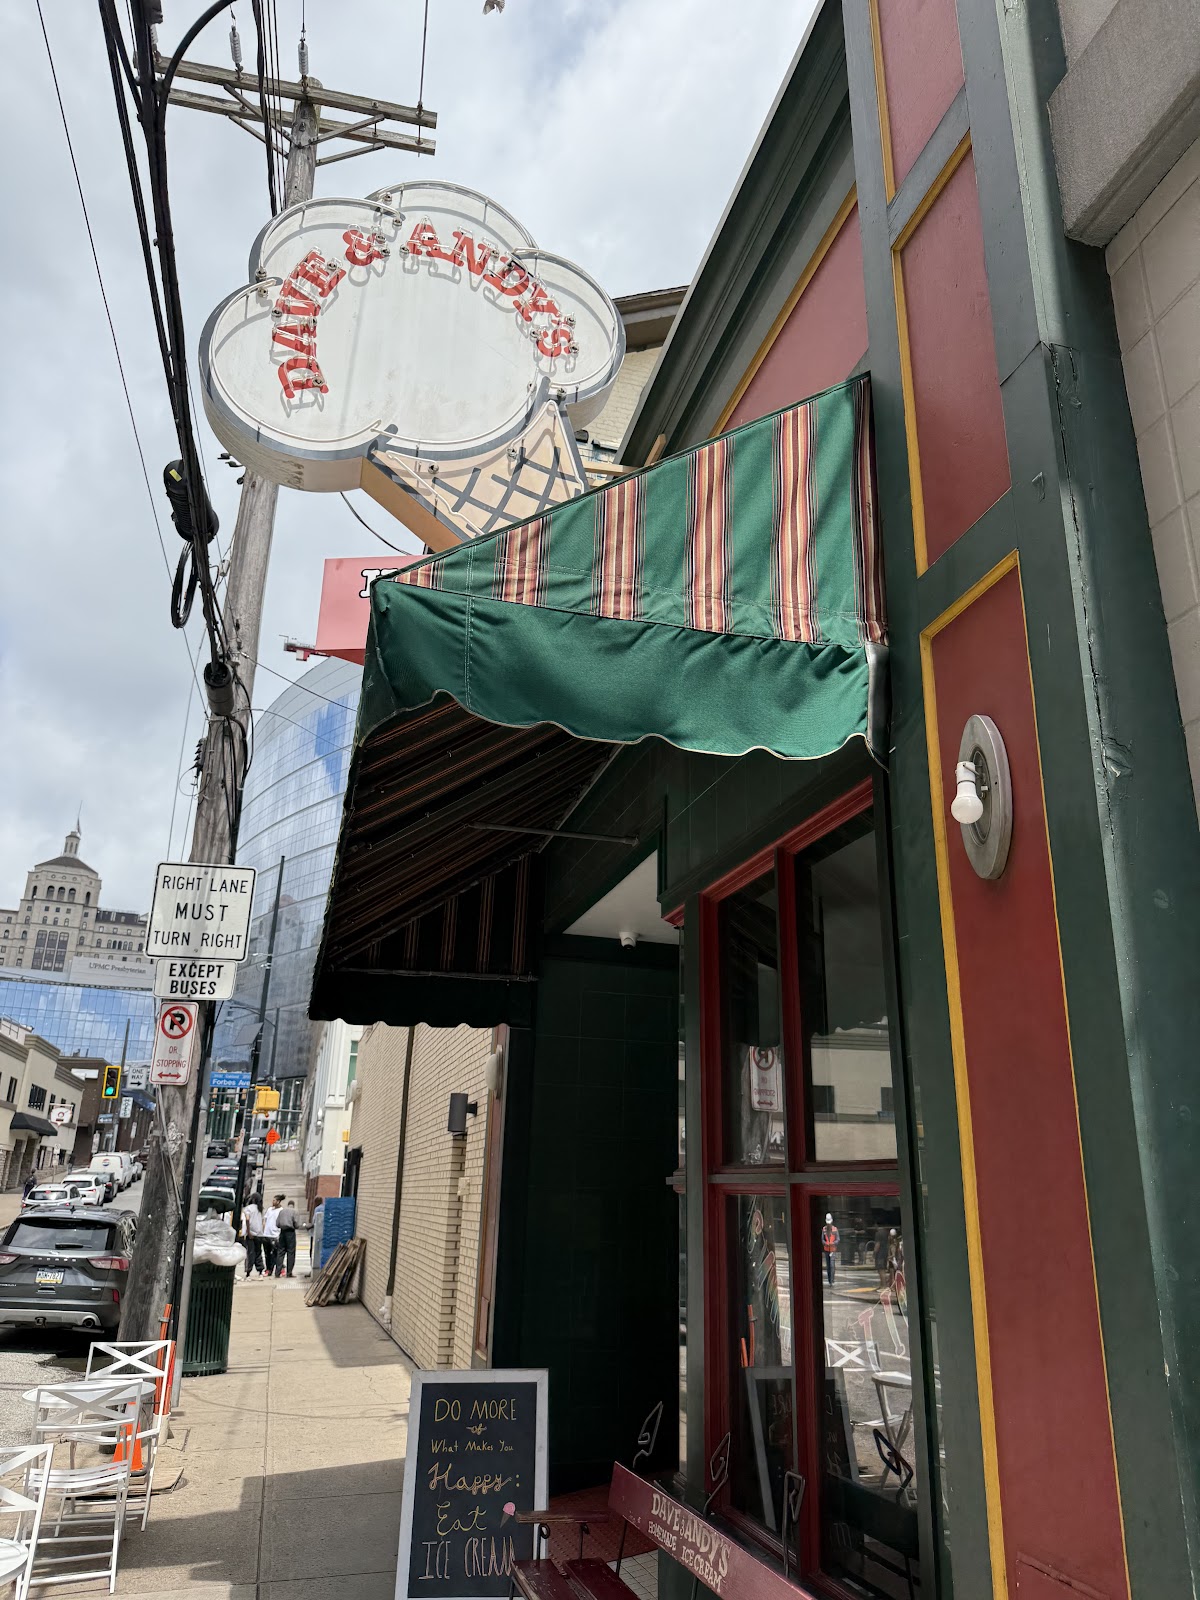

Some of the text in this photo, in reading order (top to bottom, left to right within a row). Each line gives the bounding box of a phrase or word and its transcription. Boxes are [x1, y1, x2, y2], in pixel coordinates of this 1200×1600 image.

[271, 250, 347, 399] DAVE
[342, 227, 388, 267] &
[162, 875, 248, 894] RIGHT LANE
[174, 904, 230, 922] MUST
[154, 930, 242, 950] TURN RIGHT
[89, 962, 146, 974] UPMC Presbyterian
[168, 963, 224, 979] EXCEPT
[169, 980, 217, 996] BUSES
[168, 1045, 178, 1054] OR
[156, 1058, 187, 1068] STOPPING
[212, 1078, 236, 1086] Forbes
[434, 1398, 517, 1422] DO MORE
[468, 1422, 486, 1436] of
[431, 1438, 459, 1453] What
[499, 1439, 514, 1452] You
[436, 1500, 488, 1536] Eat
[647, 1520, 677, 1551] HOMEMADE
[651, 1493, 682, 1531] DAVE
[684, 1516, 732, 1578] ANDY'S
[418, 1535, 516, 1580] ICE CREAM
